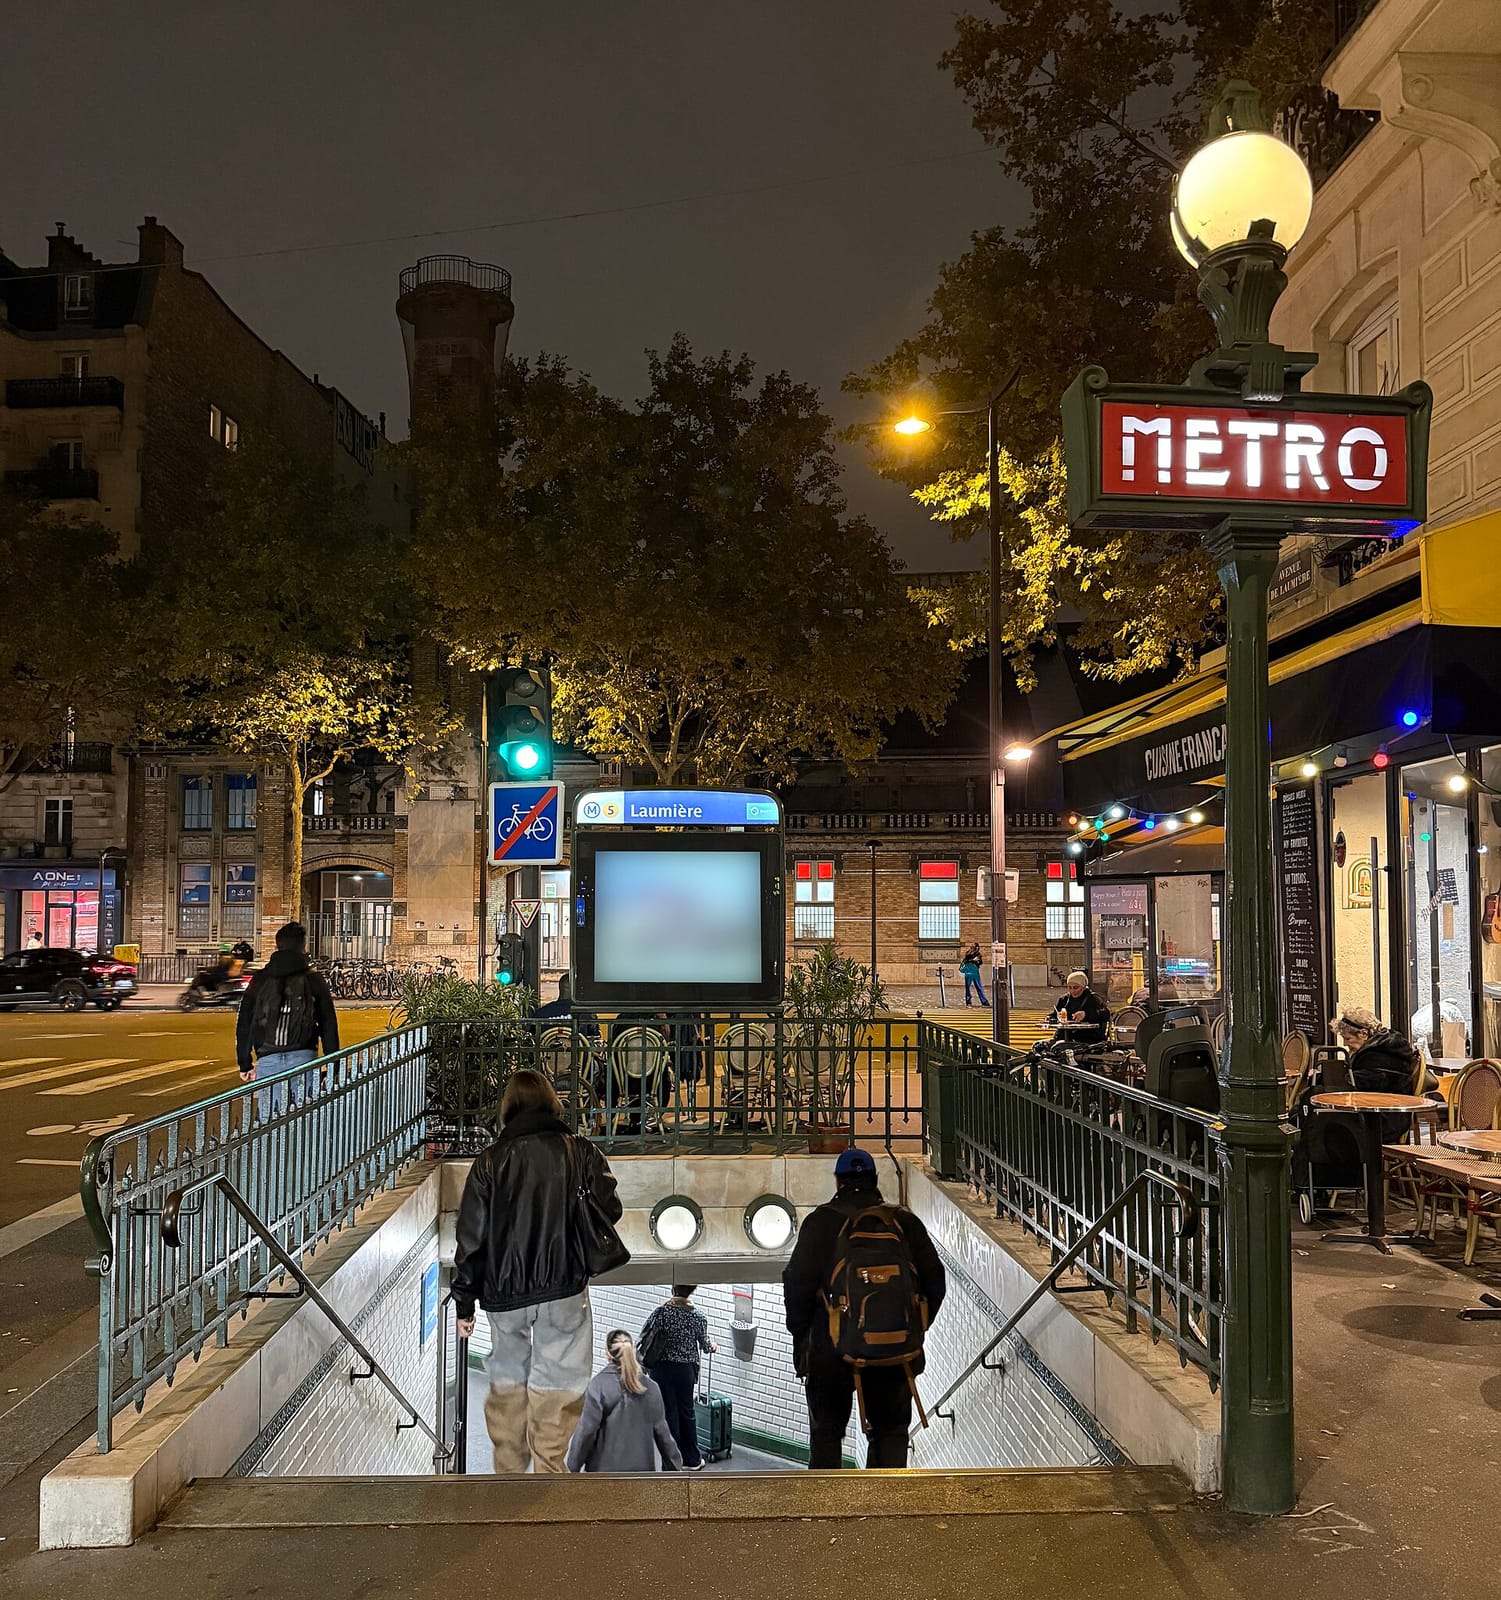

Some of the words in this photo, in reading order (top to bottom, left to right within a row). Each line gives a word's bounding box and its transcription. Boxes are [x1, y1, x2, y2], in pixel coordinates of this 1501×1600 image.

[1122, 415, 1388, 491] METRO
[1279, 560, 1302, 581] AVENUE
[1270, 588, 1279, 600] DE
[1145, 740, 1183, 781] CUISINE
[630, 803, 703, 818] Laumière
[1099, 918, 1118, 927] Formule
[1109, 936, 1127, 945] Service
